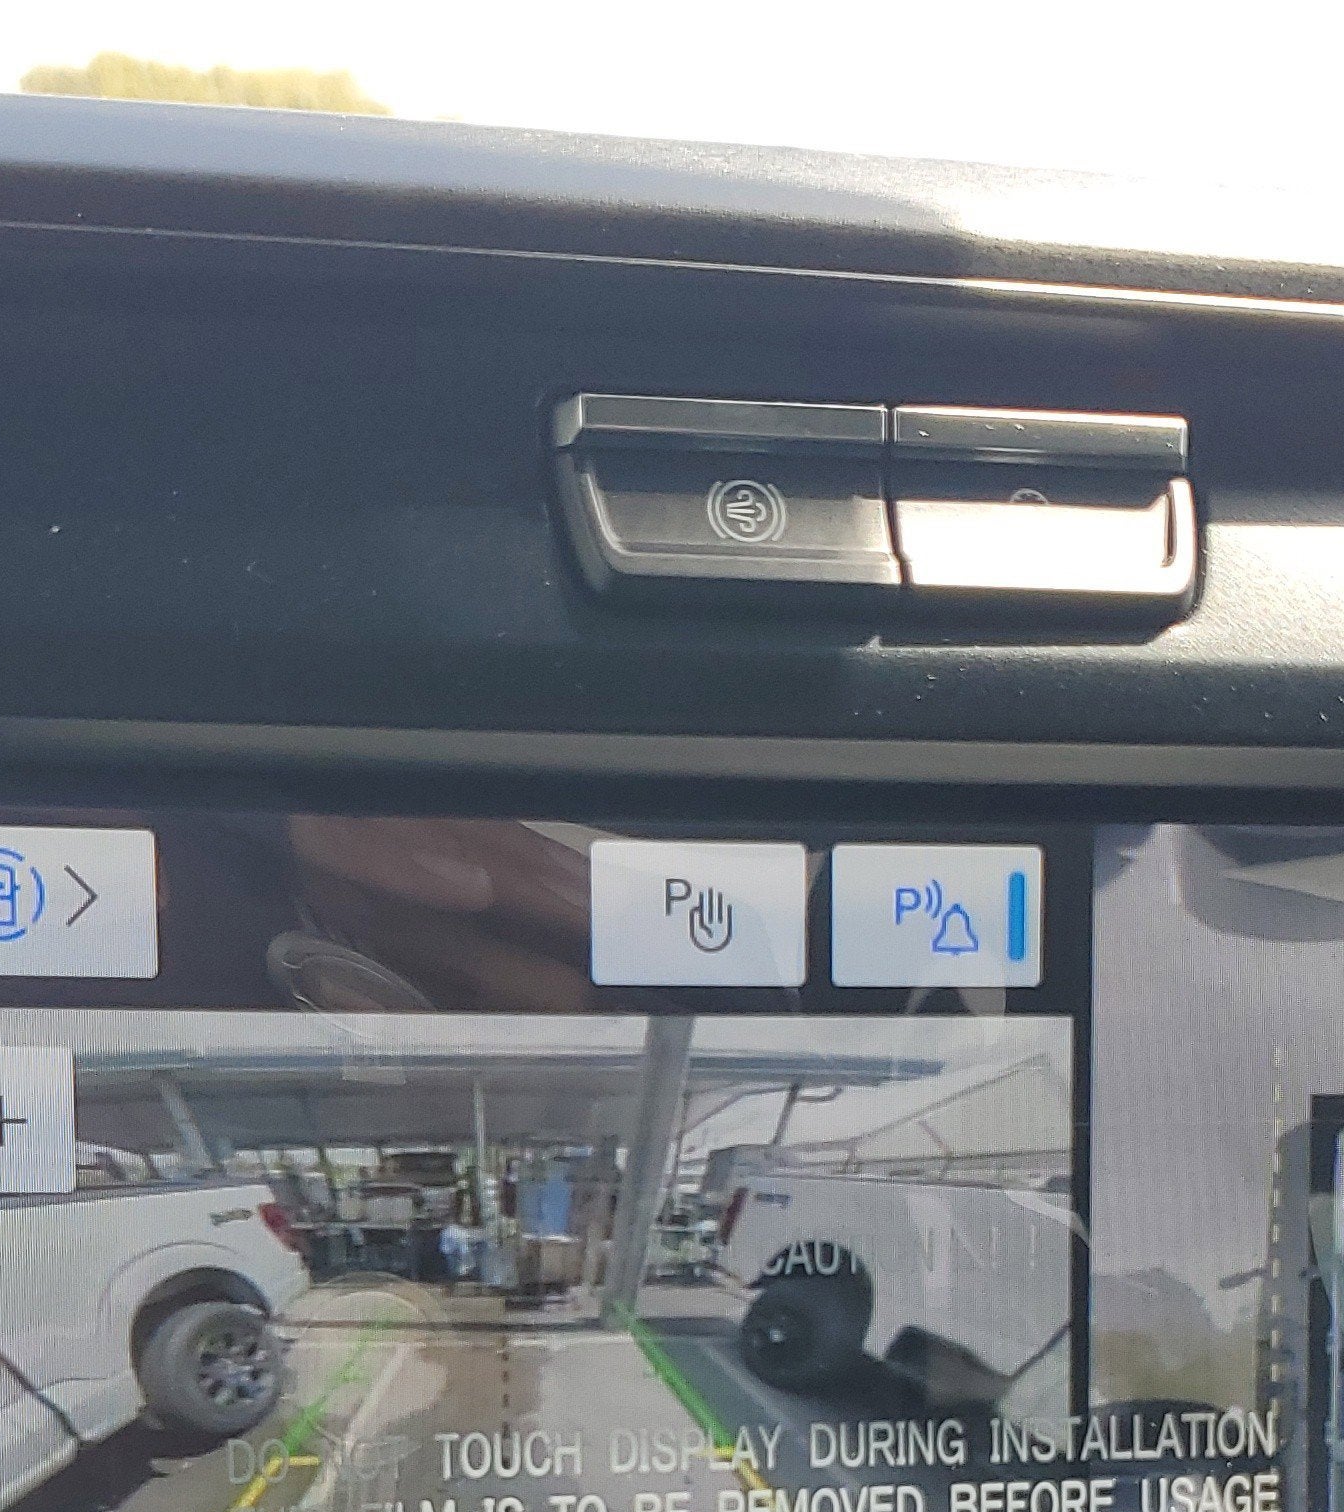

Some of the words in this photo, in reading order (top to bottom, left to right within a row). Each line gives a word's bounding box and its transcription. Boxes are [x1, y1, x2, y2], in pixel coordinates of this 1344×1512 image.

[437, 1428, 582, 1480] TOUCH
[610, 1424, 780, 1473] DISPLAY
[810, 1419, 965, 1468] DURING
[990, 1409, 1276, 1463] INSTALLATION
